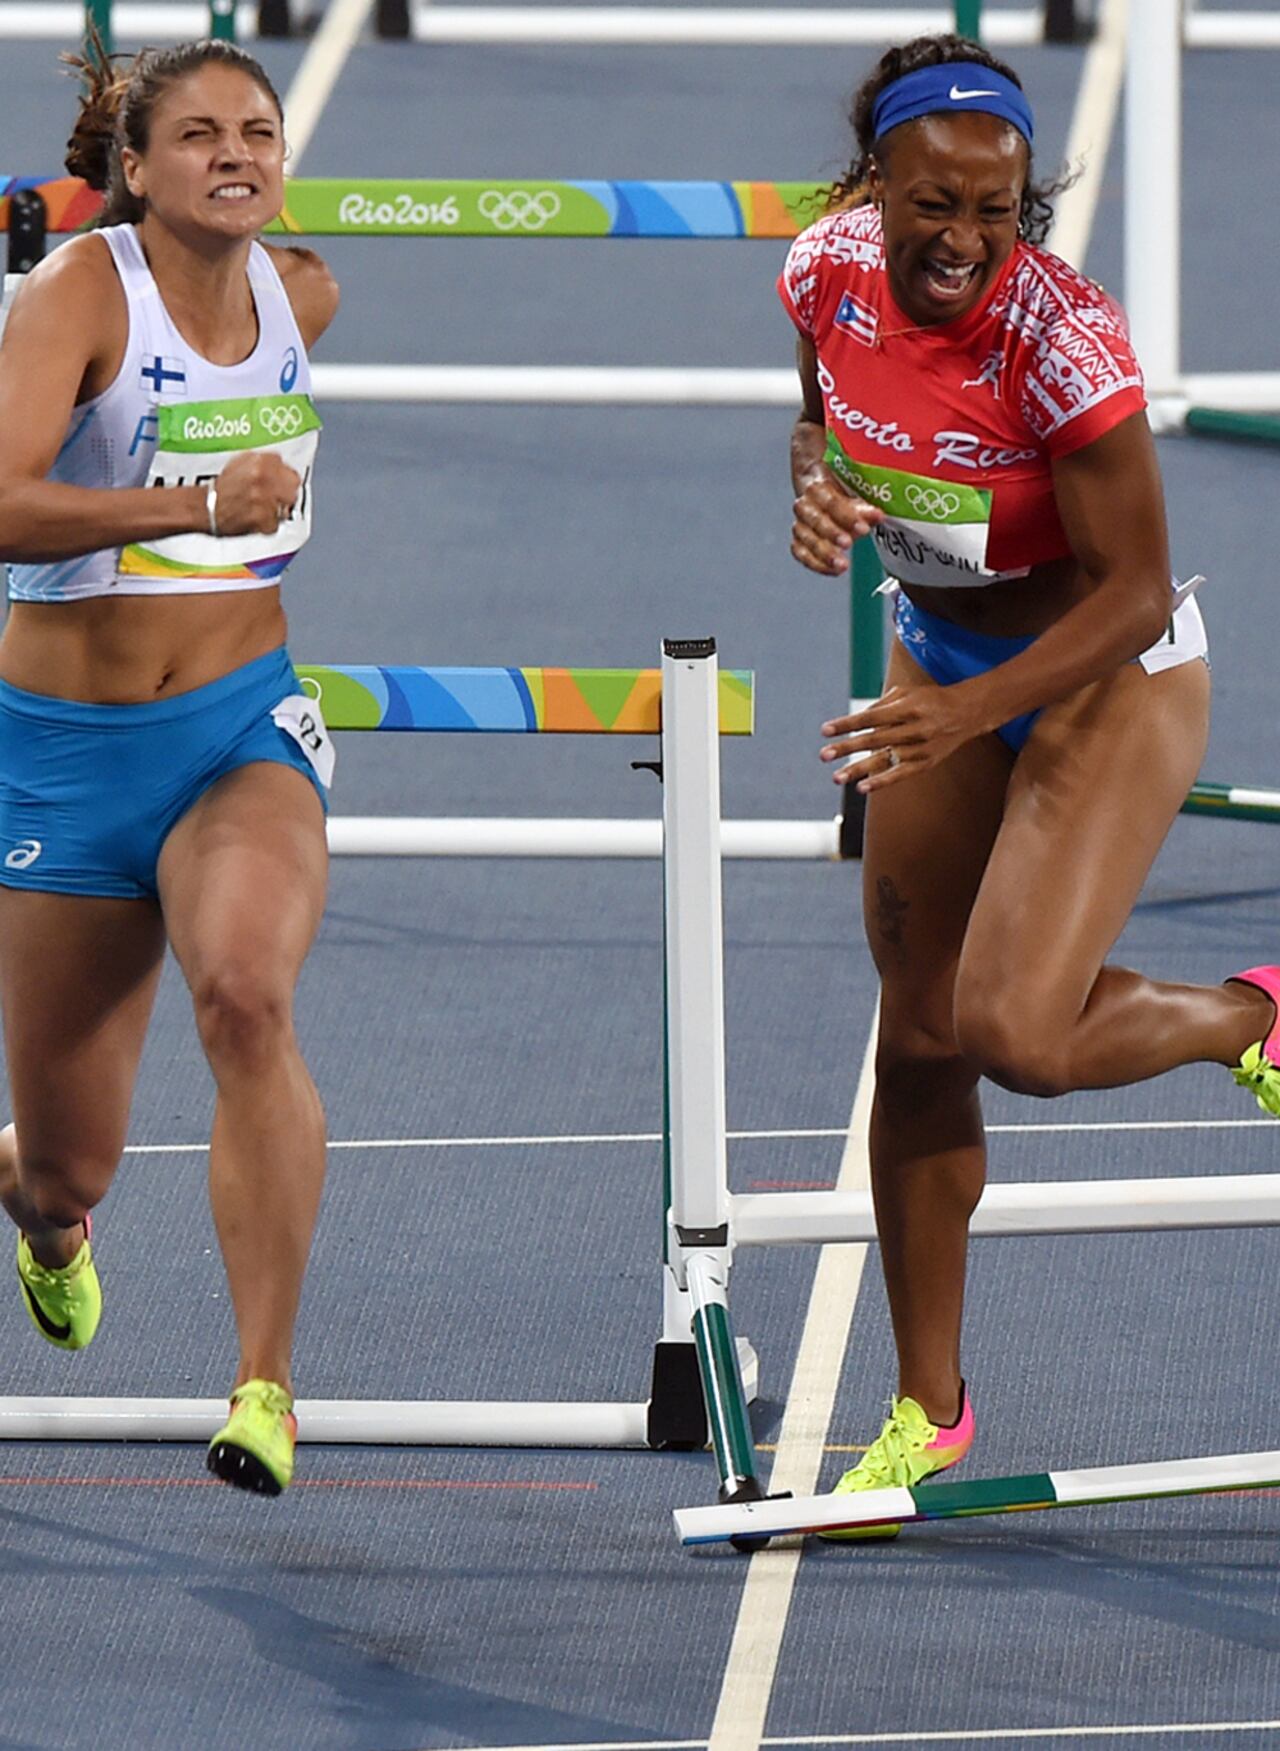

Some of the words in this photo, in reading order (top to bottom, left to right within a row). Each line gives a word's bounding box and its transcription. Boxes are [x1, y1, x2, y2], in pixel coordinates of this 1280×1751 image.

[338, 193, 460, 225] Rio2016
[183, 412, 252, 440] Rio2016
[933, 430, 1038, 469] Rico
